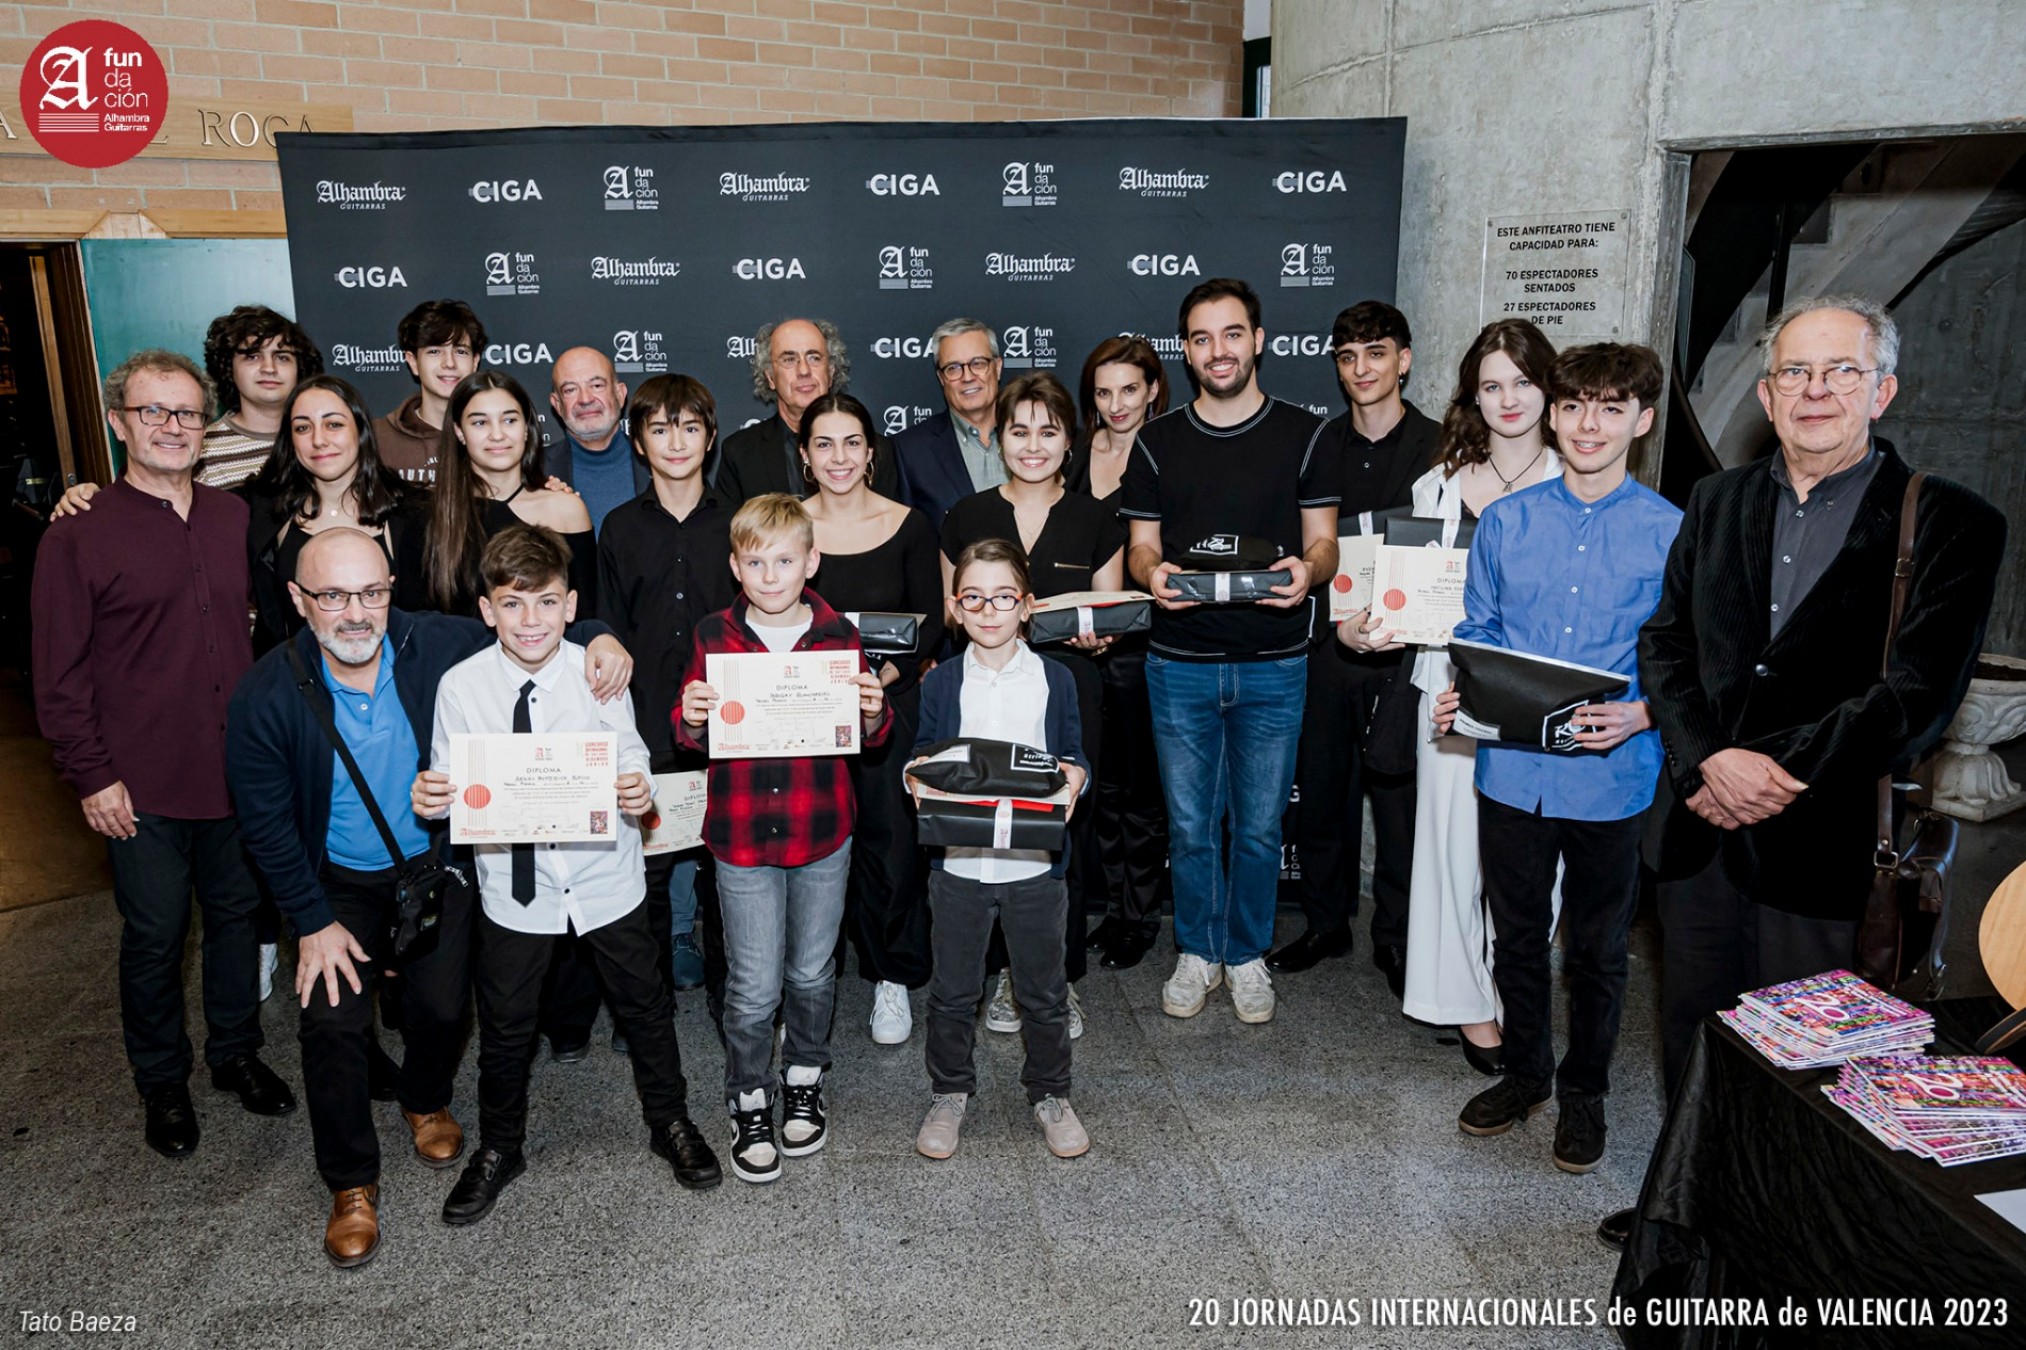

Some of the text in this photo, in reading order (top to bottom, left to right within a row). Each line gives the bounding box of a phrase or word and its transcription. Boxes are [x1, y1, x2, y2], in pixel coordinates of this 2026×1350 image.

[634, 166, 653, 177] fun
[1034, 163, 1054, 173] fun
[635, 177, 649, 188] da
[1035, 173, 1049, 184] da
[1276, 170, 1347, 193] CIGA
[870, 174, 940, 196] CIGA
[1035, 182, 1057, 194] ción
[472, 179, 543, 203] CIGA
[635, 186, 658, 198] ción
[1497, 222, 1616, 237] ESTE ANFITEATRO TIENE
[1313, 243, 1332, 255] fun
[1510, 238, 1599, 250] CAPACIDAD PARA:
[910, 246, 929, 257] fun
[515, 252, 534, 263] fun
[910, 257, 924, 268] da
[1312, 254, 1326, 265] da
[516, 262, 530, 274] da
[736, 257, 806, 280] CIGA
[1131, 254, 1200, 276] CIGA
[1312, 263, 1334, 275] ción
[910, 265, 932, 277] ción
[1506, 269, 1599, 280] 70 ESPECTADORES
[338, 266, 407, 288] CIGA
[517, 271, 539, 283] ción
[1524, 283, 1576, 293] SENTADOS
[1504, 302, 1596, 311] 27 ESPECTADORES
[1531, 316, 1563, 324] DE PIE
[644, 331, 662, 341] fun
[1034, 327, 1053, 337] fun
[644, 341, 658, 352] da
[1034, 337, 1048, 348] da
[332, 344, 406, 368] Alhambr
[485, 343, 553, 365] CIGA
[645, 350, 667, 361] ción
[1034, 346, 1056, 357] ción
[914, 406, 932, 417] fun
[1309, 404, 1327, 414] fun
